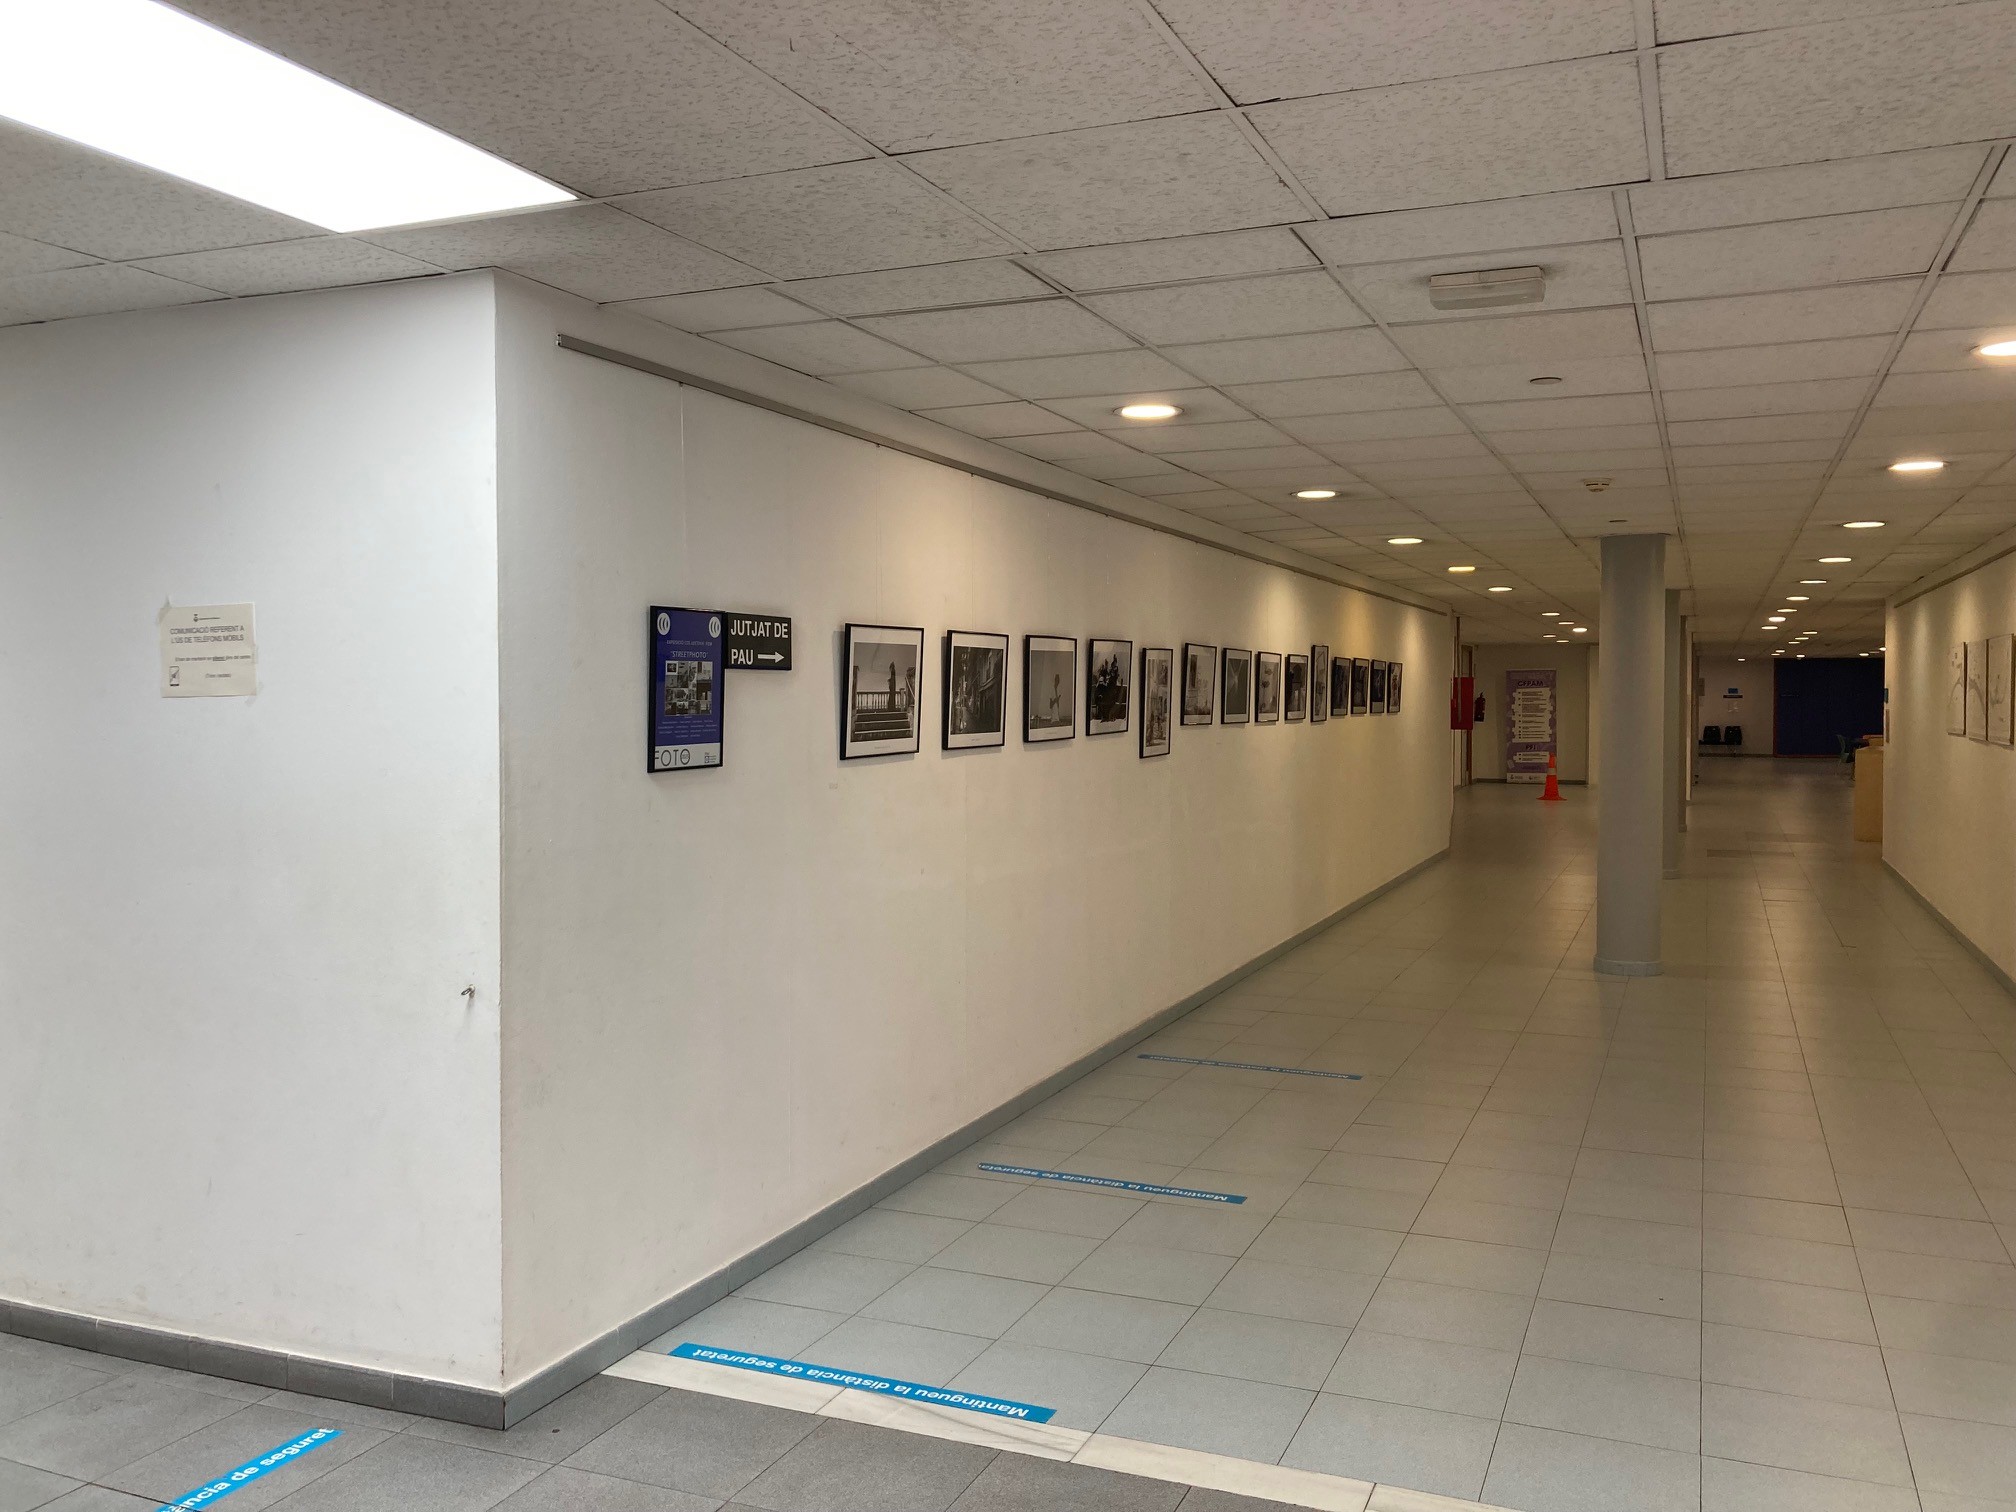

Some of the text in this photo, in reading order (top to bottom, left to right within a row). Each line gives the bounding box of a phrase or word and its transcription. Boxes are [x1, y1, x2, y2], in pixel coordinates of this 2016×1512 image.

[210, 625, 239, 633] REFERENT
[730, 619, 789, 639] JUTJAT DE
[731, 648, 754, 665] PAU
[1143, 1186, 1228, 1201] Mantingueu
[692, 1348, 1030, 1417] Mantingueu la distància de seguretat
[231, 1465, 260, 1481] de
